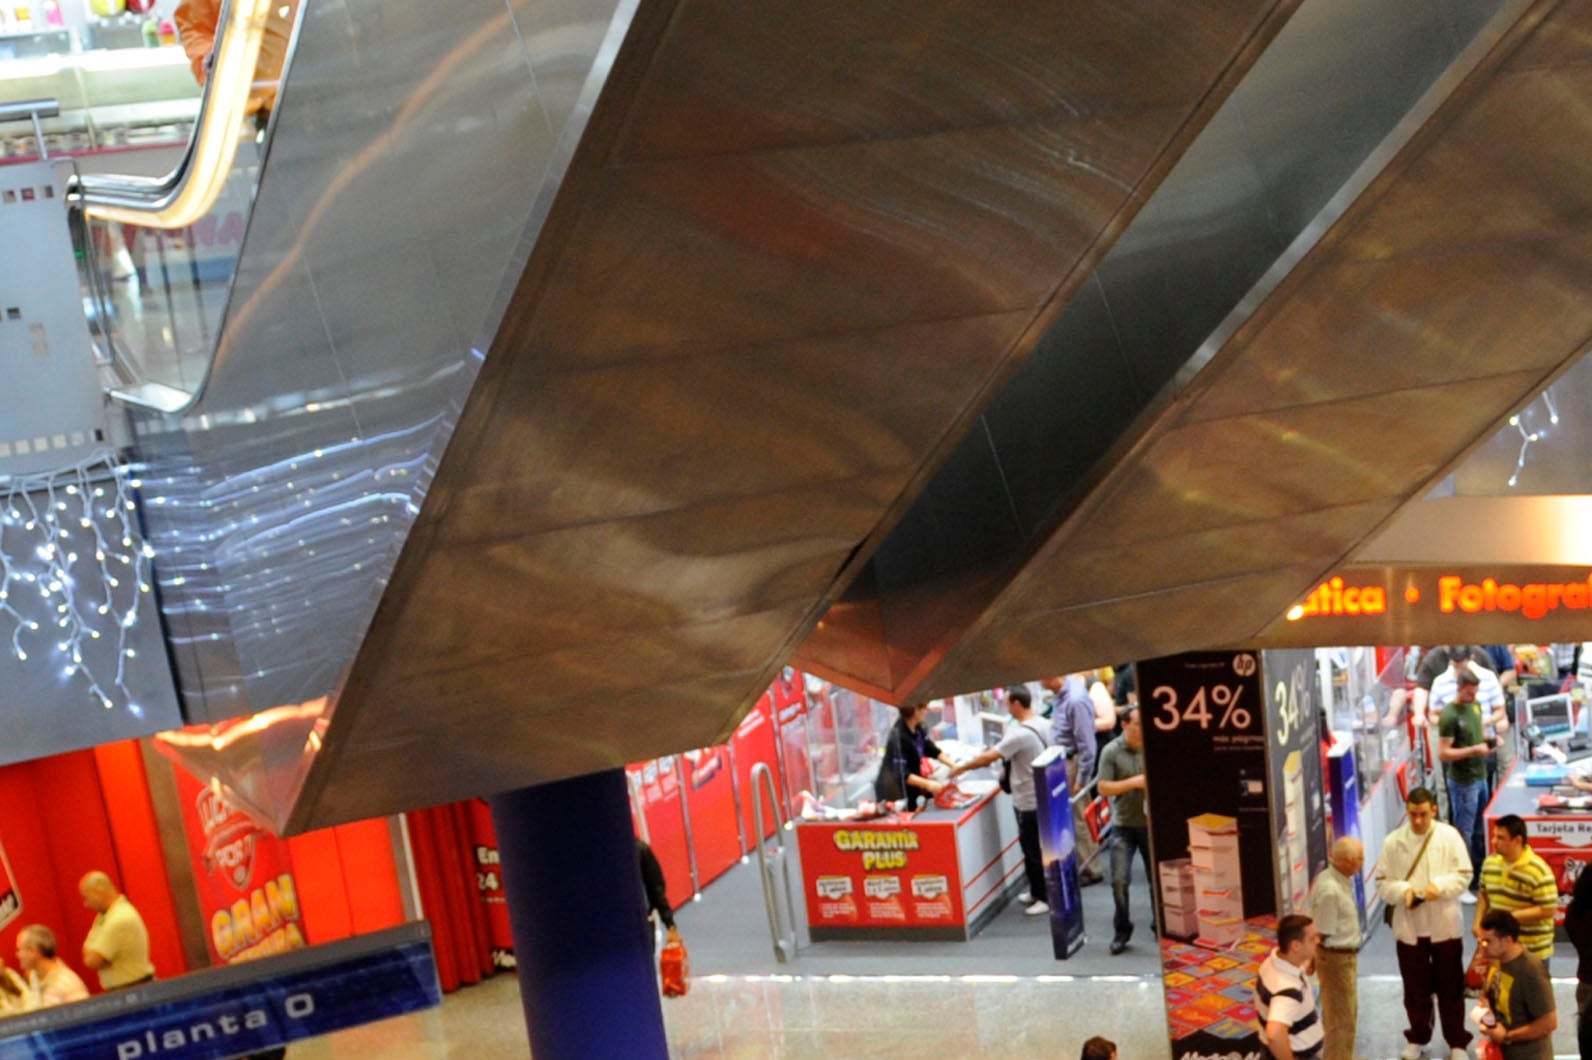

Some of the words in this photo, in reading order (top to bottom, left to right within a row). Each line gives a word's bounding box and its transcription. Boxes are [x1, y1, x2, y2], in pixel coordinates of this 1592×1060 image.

[1152, 684, 1251, 731] 34%
[1537, 823, 1574, 834] Tarjeta
[862, 850, 907, 871] PLUS
[211, 873, 299, 959] GRAN
